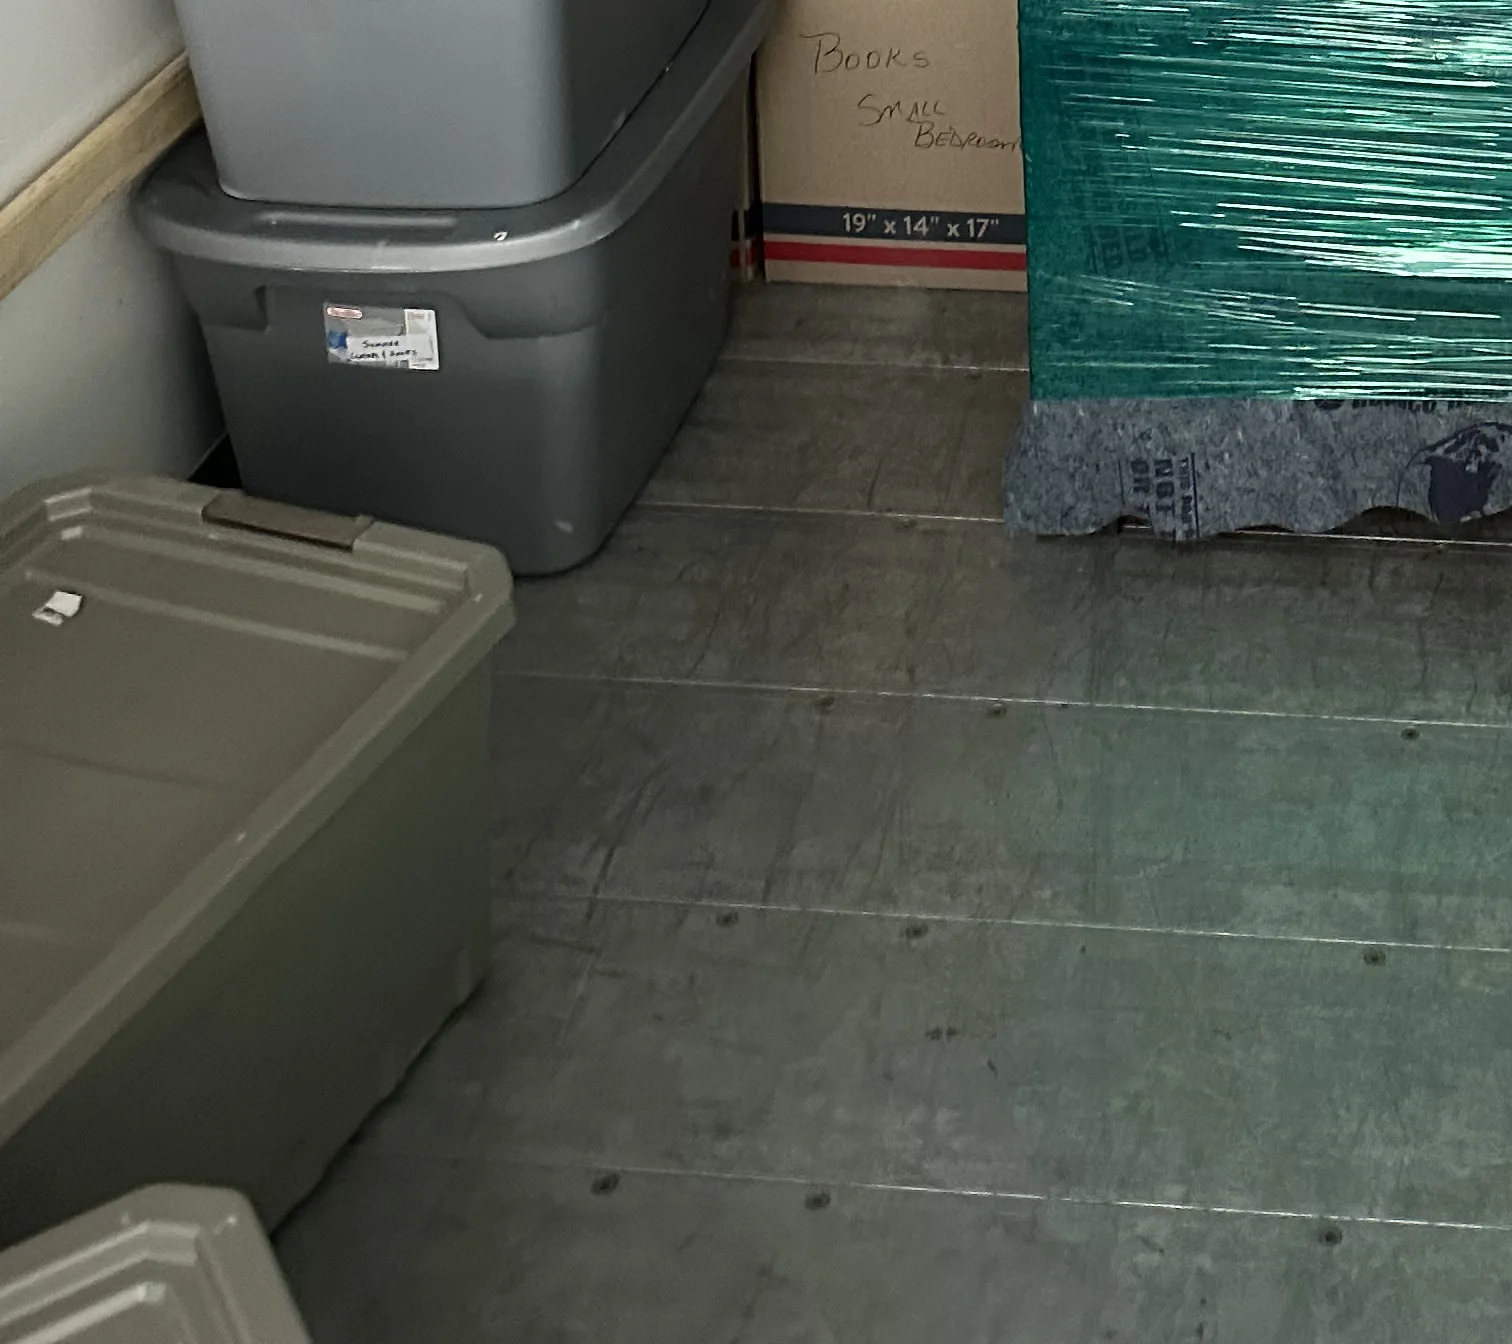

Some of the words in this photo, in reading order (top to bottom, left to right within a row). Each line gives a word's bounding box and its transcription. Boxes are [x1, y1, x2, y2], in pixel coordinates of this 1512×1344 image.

[842, 212, 877, 234] 19"
[883, 220, 897, 235] x
[904, 215, 939, 237] 14"
[947, 223, 960, 238] x
[966, 218, 999, 238] 17"
